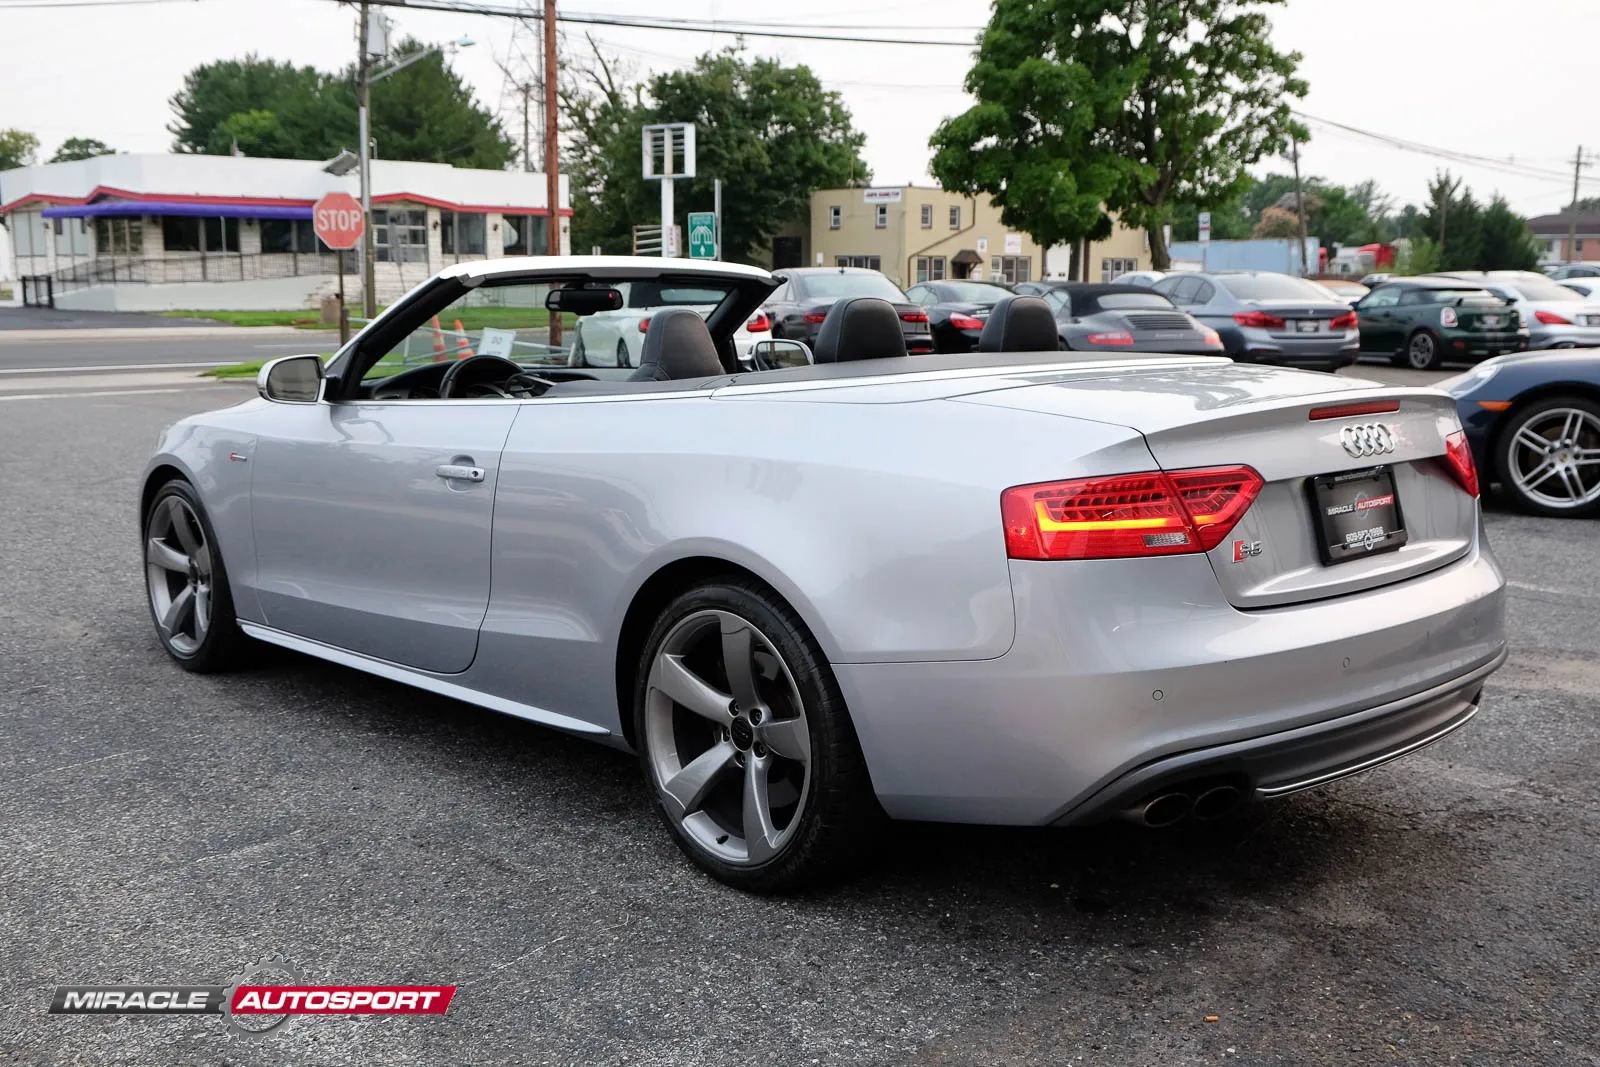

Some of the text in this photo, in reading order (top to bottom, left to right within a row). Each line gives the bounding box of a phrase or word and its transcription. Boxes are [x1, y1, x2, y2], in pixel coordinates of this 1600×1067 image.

[317, 209, 361, 231] STOP
[1327, 496, 1392, 516] MIRACLE AUTOSPORT
[1236, 540, 1263, 560] S5
